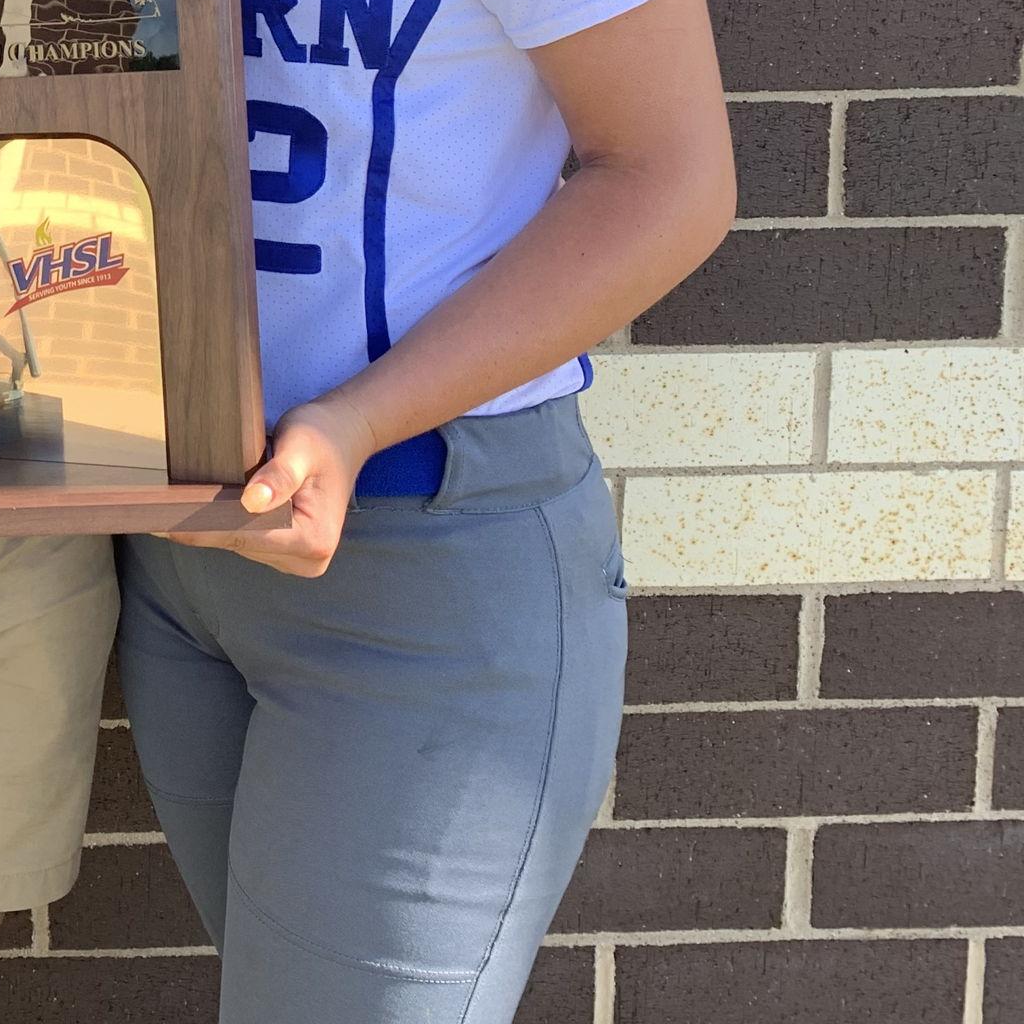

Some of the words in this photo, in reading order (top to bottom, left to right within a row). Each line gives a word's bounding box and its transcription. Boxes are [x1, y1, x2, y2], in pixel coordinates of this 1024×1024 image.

[8, 39, 147, 64] CHAMPIONS
[7, 232, 125, 297] VHSL
[28, 286, 55, 301] SERVING
[55, 280, 76, 292] YOUTH
[77, 276, 95, 286] SINCE
